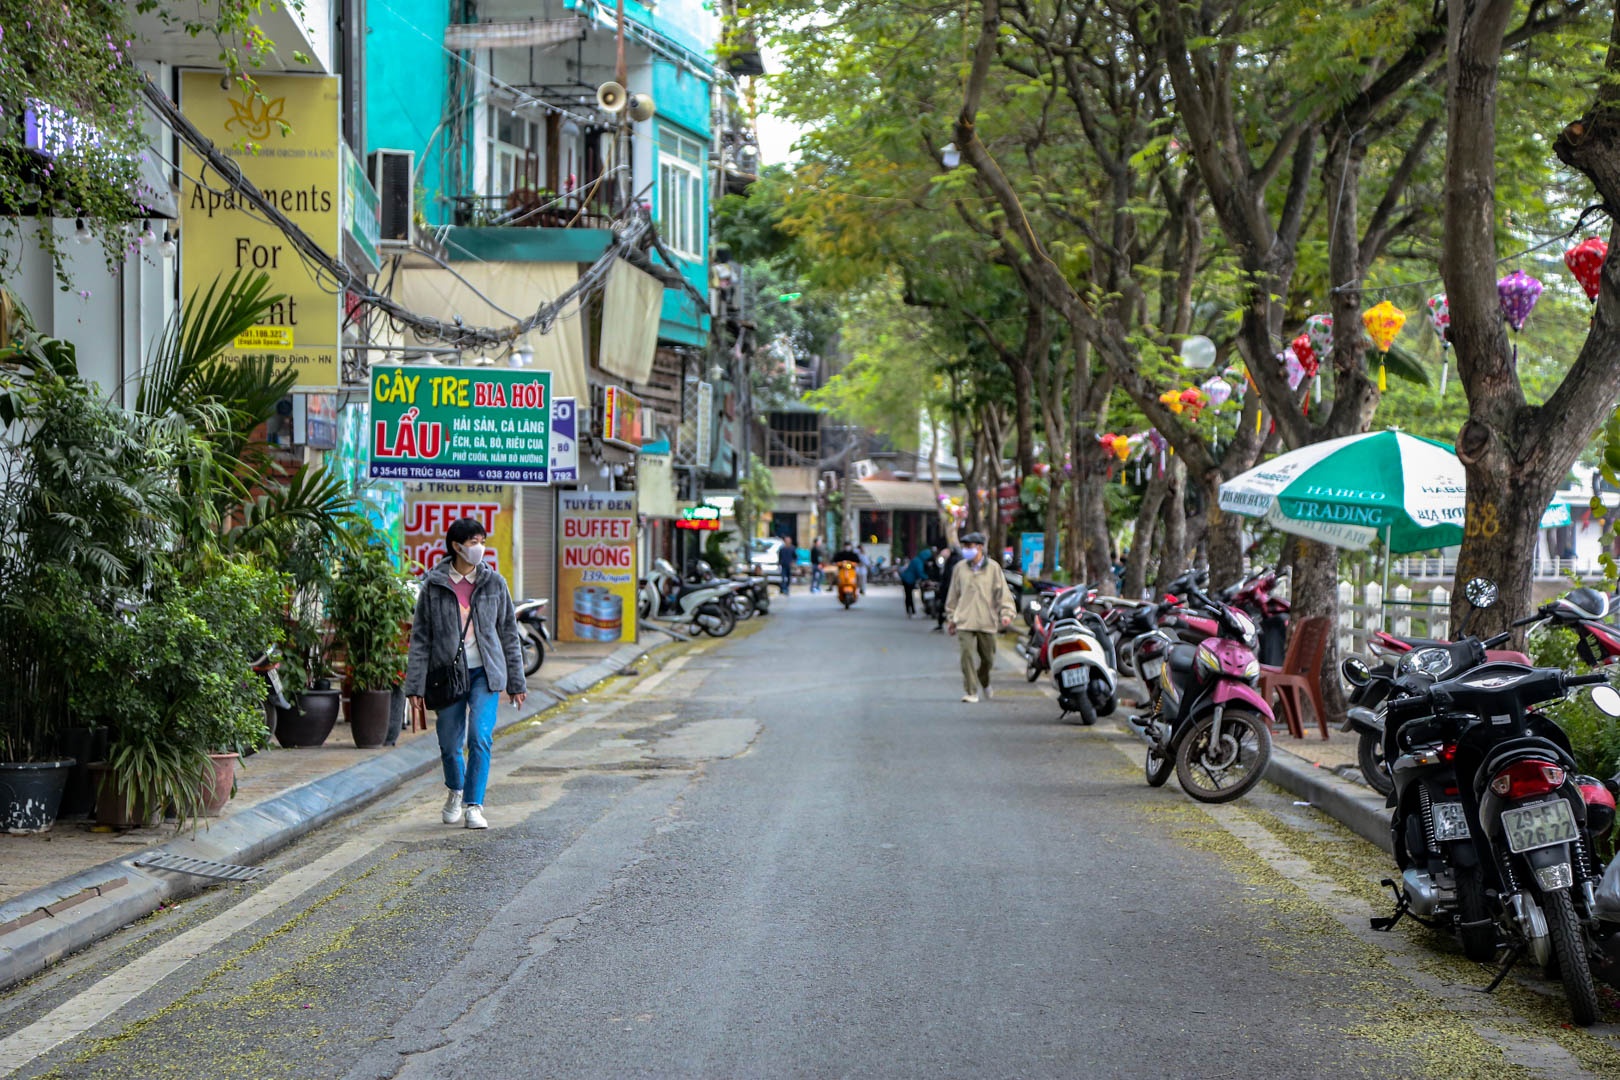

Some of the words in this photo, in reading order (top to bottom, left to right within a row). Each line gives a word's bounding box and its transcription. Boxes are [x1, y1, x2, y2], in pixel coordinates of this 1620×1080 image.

[235, 238, 282, 268] For
[318, 355, 331, 364] HN
[375, 368, 420, 404] CÂY
[429, 375, 470, 406] TRE
[474, 382, 506, 408] BIA
[510, 379, 545, 409] HƠI
[374, 407, 442, 458] LẨU
[453, 415, 470, 431] HẢI
[474, 416, 498, 433] SẢN,
[517, 418, 545, 434] LĂNG
[527, 438, 544, 450] CUA
[380, 466, 408, 477] 35-41B
[410, 465, 433, 477] TRÚC
[435, 467, 460, 479] BẠCH
[486, 470, 502, 479] 038
[504, 471, 521, 480] 200
[522, 471, 544, 480] 6118
[1307, 485, 1386, 500] HABECO
[608, 499, 632, 510] ĐEN
[1295, 501, 1382, 524] TRADING
[1416, 508, 1439, 520] BIA
[404, 503, 498, 533] UFFET
[564, 518, 631, 538] BUFFET
[564, 543, 631, 567] NƯỚNG
